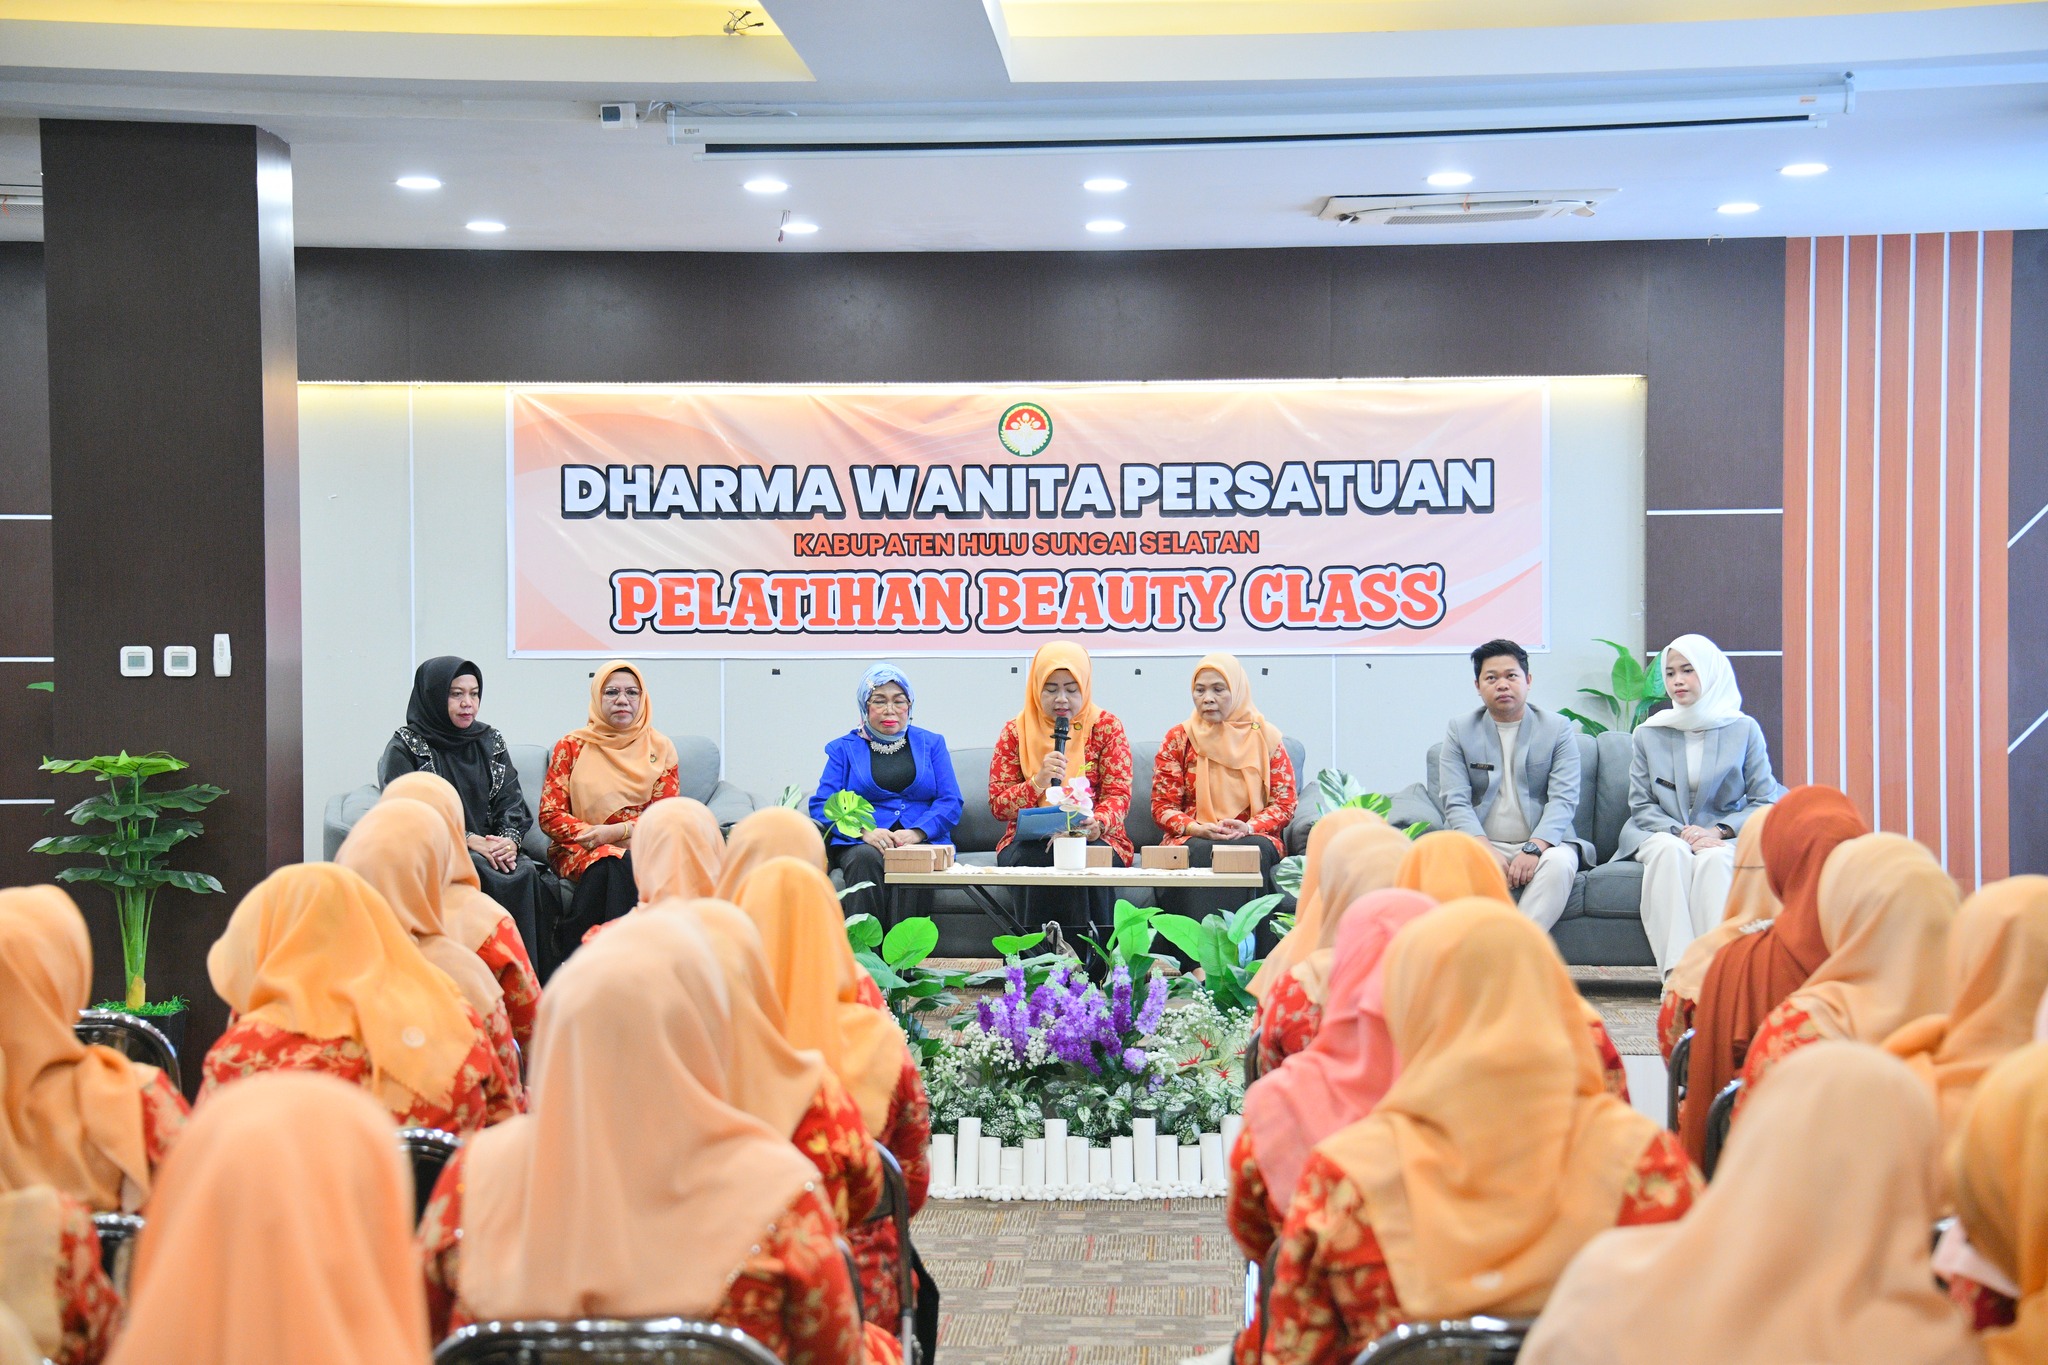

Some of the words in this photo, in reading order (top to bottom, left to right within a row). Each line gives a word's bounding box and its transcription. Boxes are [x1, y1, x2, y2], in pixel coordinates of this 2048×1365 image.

[561, 465, 845, 518] DHARMA
[851, 463, 1115, 517] WANITA
[1122, 460, 1494, 514] PERSATUAN
[794, 533, 955, 557] KABUPATEN
[958, 533, 1029, 556] HULU
[1032, 532, 1136, 556] SUNGAI
[1141, 530, 1260, 554] SELATAN
[609, 570, 972, 634] PELATIHAN
[976, 569, 1235, 633] BEAUTY
[1242, 564, 1446, 630] CLASS
